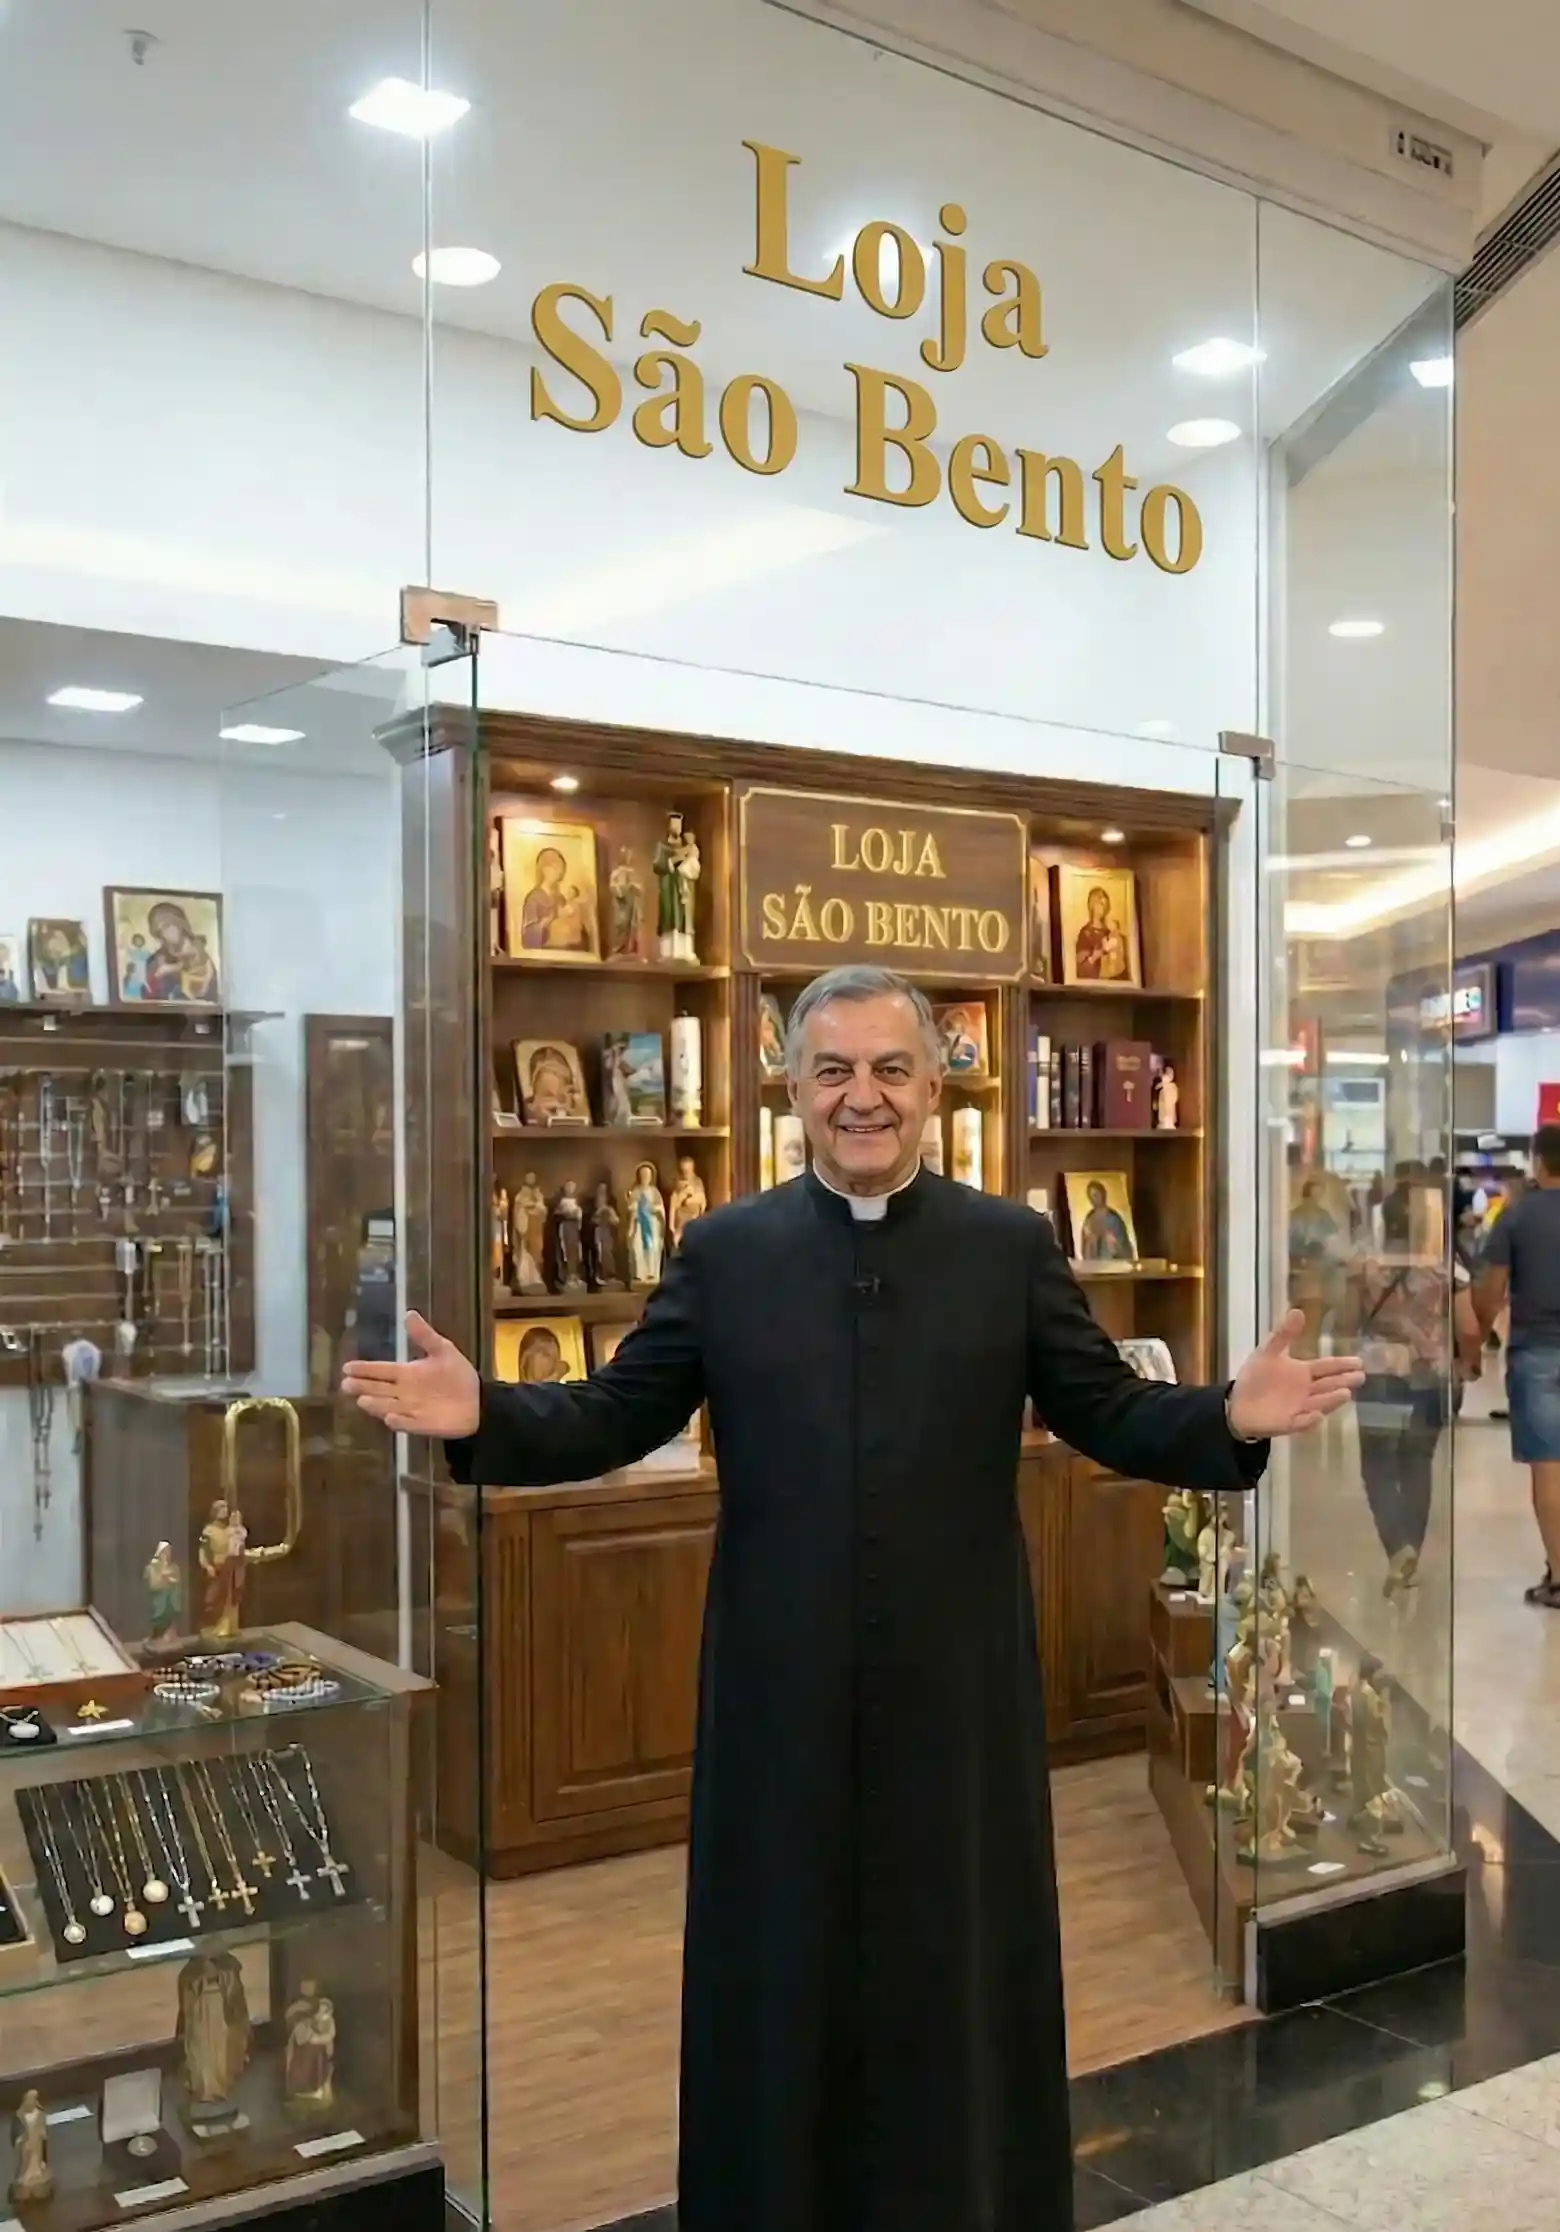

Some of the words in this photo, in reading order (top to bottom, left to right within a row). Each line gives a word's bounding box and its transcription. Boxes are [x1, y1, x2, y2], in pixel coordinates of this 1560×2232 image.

[741, 140, 1049, 372] Loja
[530, 283, 797, 476] São
[844, 361, 1203, 575] Bento
[762, 884, 855, 943] SÃO
[865, 901, 1009, 953] BENTO
[830, 824, 946, 878] LOJA
